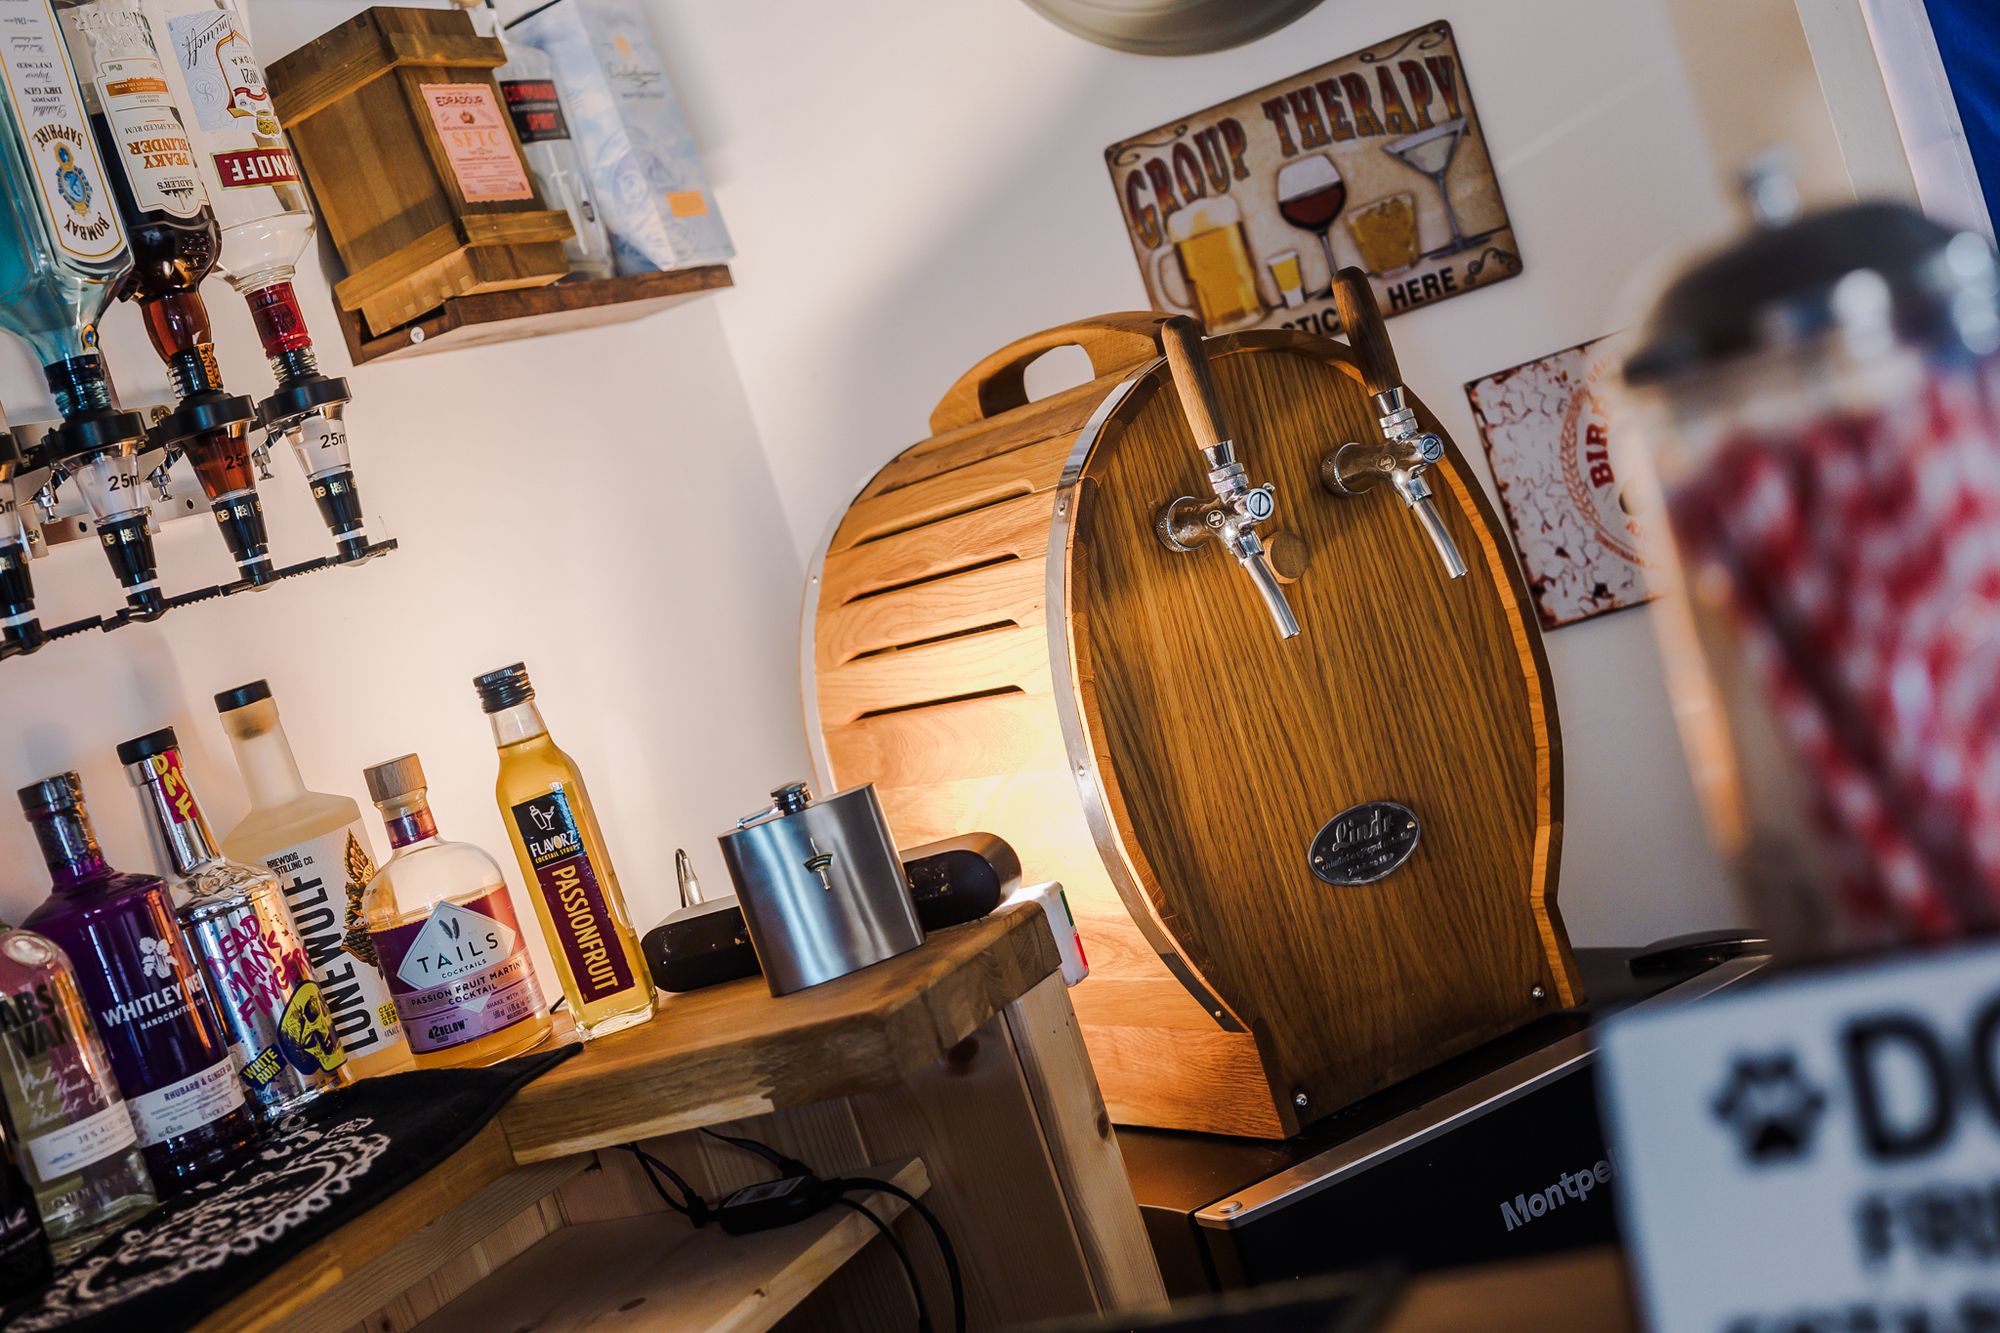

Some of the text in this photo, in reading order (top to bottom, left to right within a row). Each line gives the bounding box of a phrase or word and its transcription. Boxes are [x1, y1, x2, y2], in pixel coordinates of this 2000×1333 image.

[24, 86, 63, 95] DRY GIN
[32, 124, 84, 152] SAPPHIRE
[124, 126, 143, 134] RUM
[126, 138, 189, 155] BLINDER
[1125, 54, 1471, 250] GROUP THERAPY
[143, 153, 190, 169] PEAKY
[156, 179, 194, 190] SADLER'S
[64, 211, 111, 241] BOMBAY
[1386, 266, 1458, 311] HERE
[529, 830, 578, 858] FLAVORZ
[551, 864, 620, 991] PASSIONFRUIT
[205, 914, 261, 980] DEAD
[416, 932, 499, 974] TAILS
[226, 929, 283, 1002] MAN'S
[441, 958, 488, 979] COCKTAILS
[101, 982, 183, 1028] WHITLEY
[411, 989, 452, 1006] PASSION
[454, 976, 487, 994] FRUIT
[447, 983, 498, 1006] COCKTAIL
[243, 1047, 279, 1080] WHITE
[255, 1060, 282, 1086] RUM
[163, 1079, 200, 1102] RHUBARB
